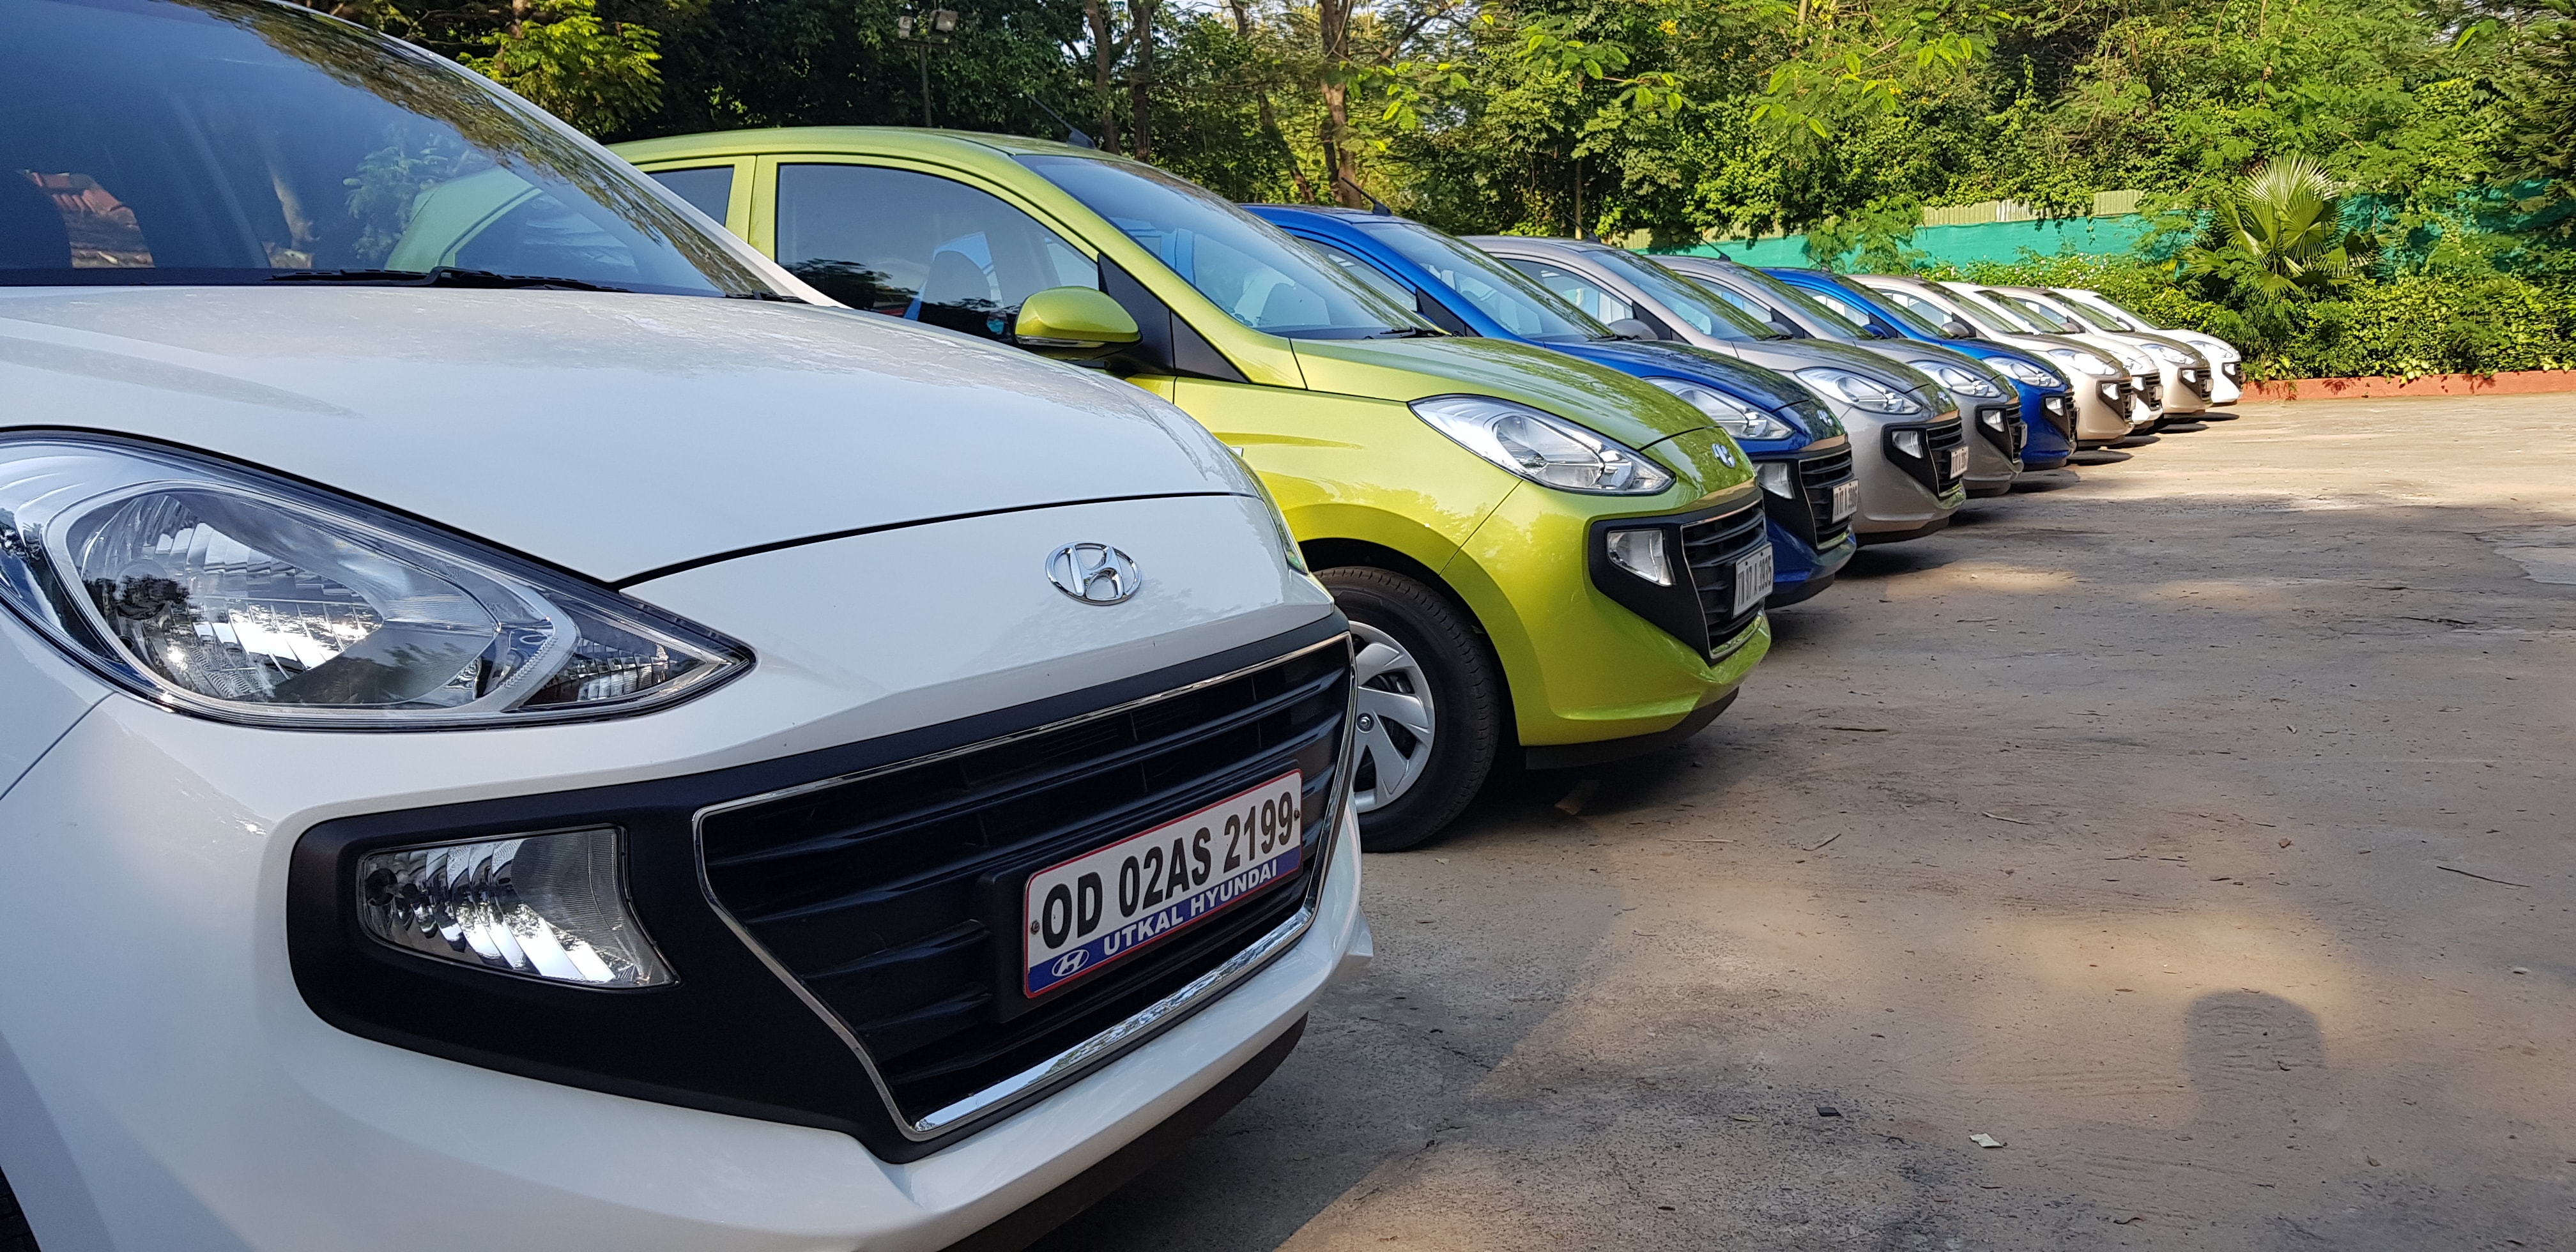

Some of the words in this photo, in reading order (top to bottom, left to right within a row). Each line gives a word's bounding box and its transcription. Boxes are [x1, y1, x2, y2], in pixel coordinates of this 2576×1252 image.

[1043, 871, 1103, 950] OD
[1119, 827, 1211, 919] 02AS
[1223, 791, 1293, 874] 2199
[1103, 908, 1184, 956] UTKAL
[1190, 859, 1278, 916] HYUNDAI
